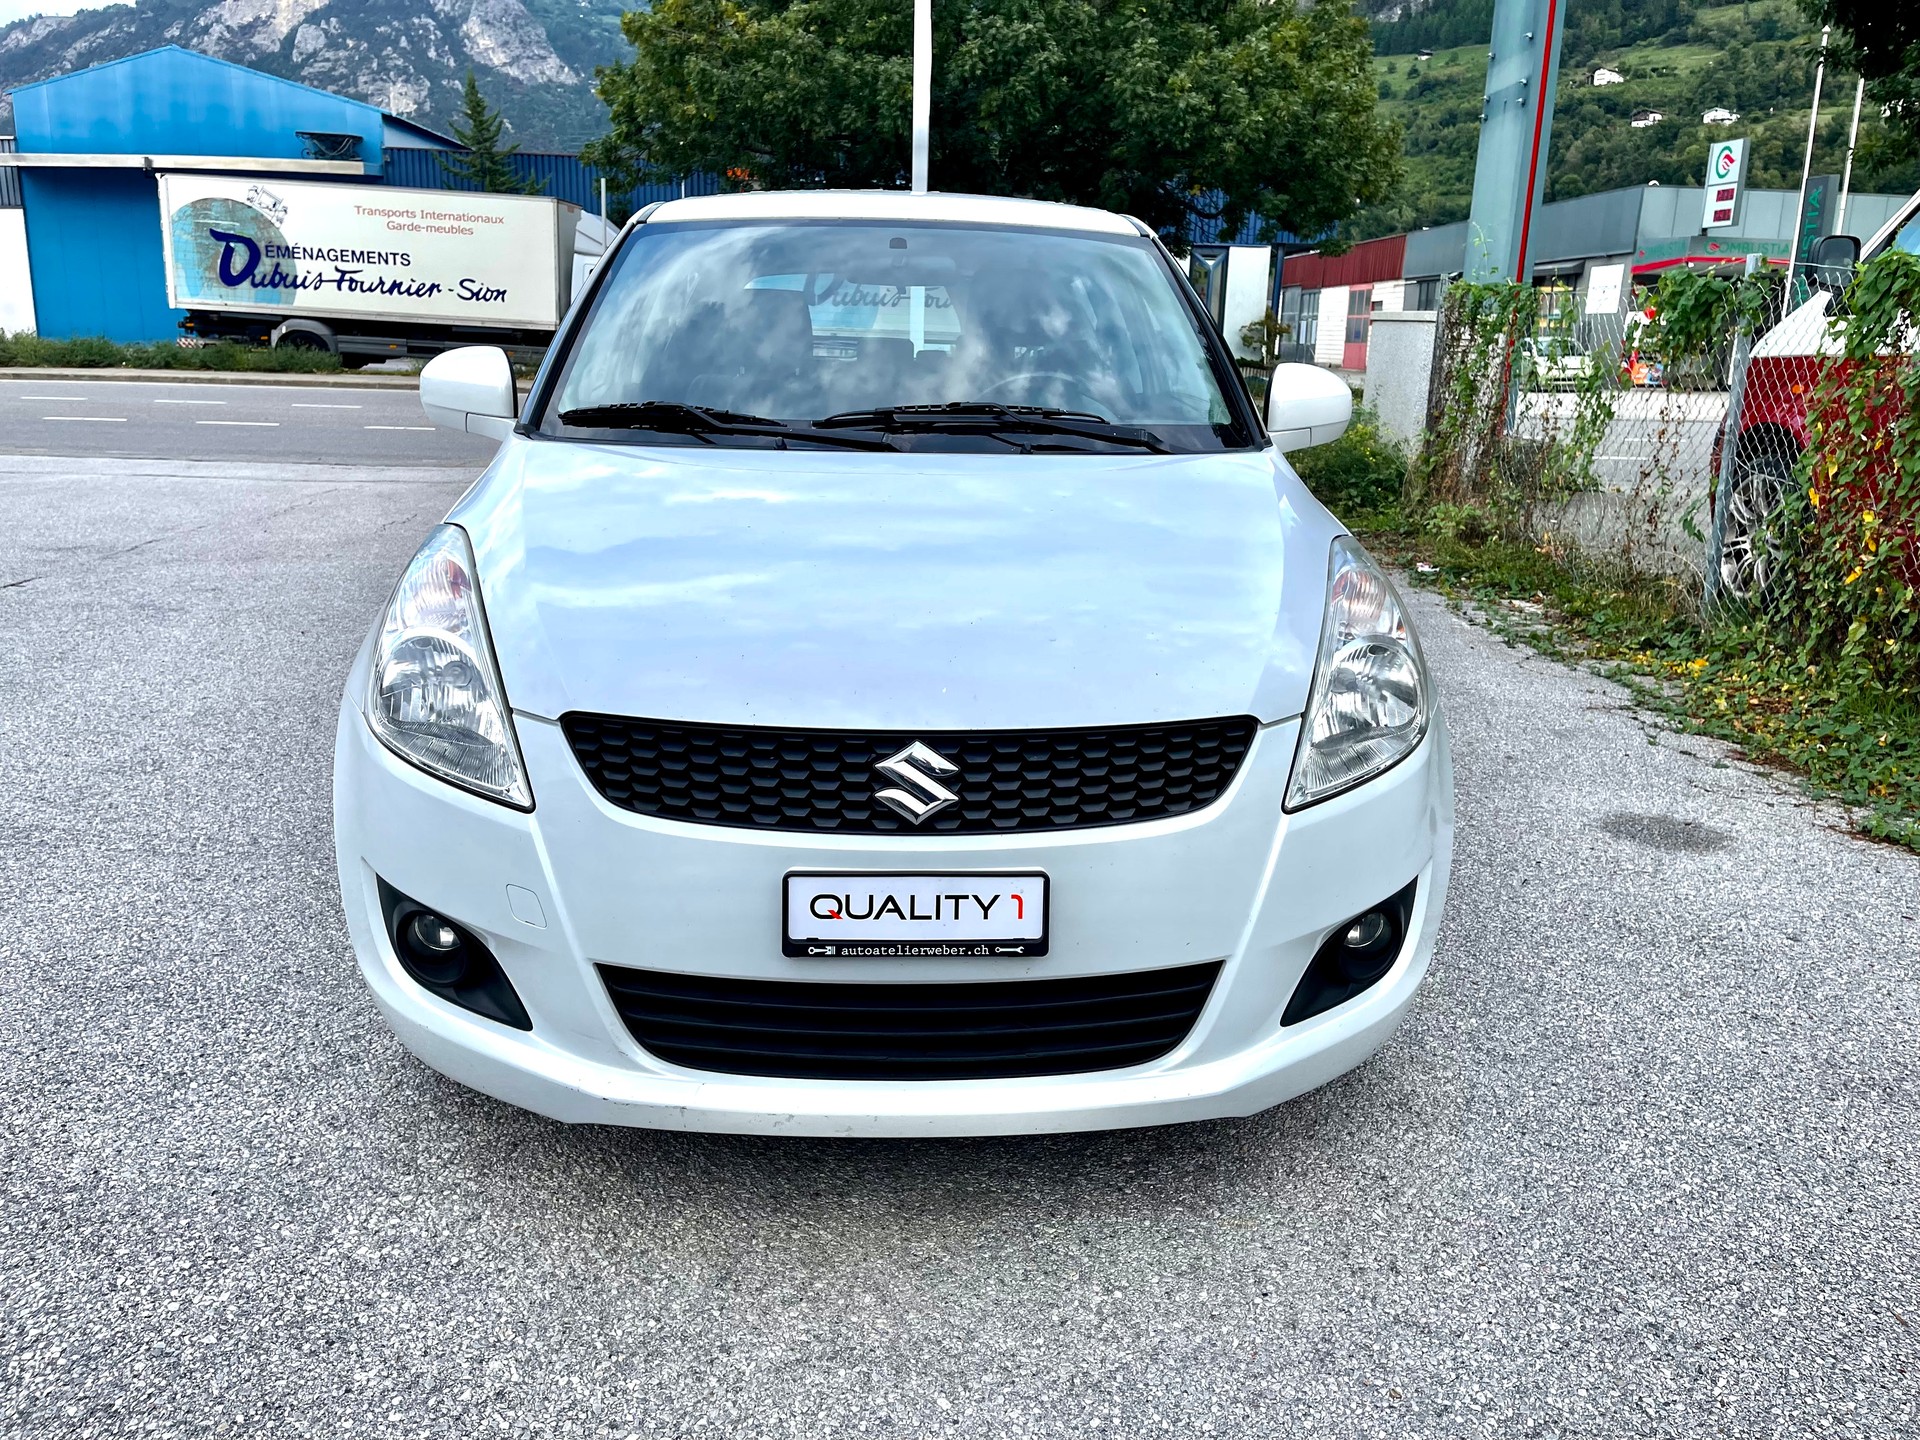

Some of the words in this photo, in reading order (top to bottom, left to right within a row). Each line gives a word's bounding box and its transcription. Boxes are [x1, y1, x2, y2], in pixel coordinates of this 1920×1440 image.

[354, 205, 417, 219] Transports
[420, 210, 505, 225] Internationaux
[386, 220, 474, 236] Garde-meubles
[457, 278, 508, 302] Sion
[809, 893, 1001, 920] QUALITY
[1010, 894, 1024, 920] 1
[841, 945, 990, 956] autoatelierweber.ch
